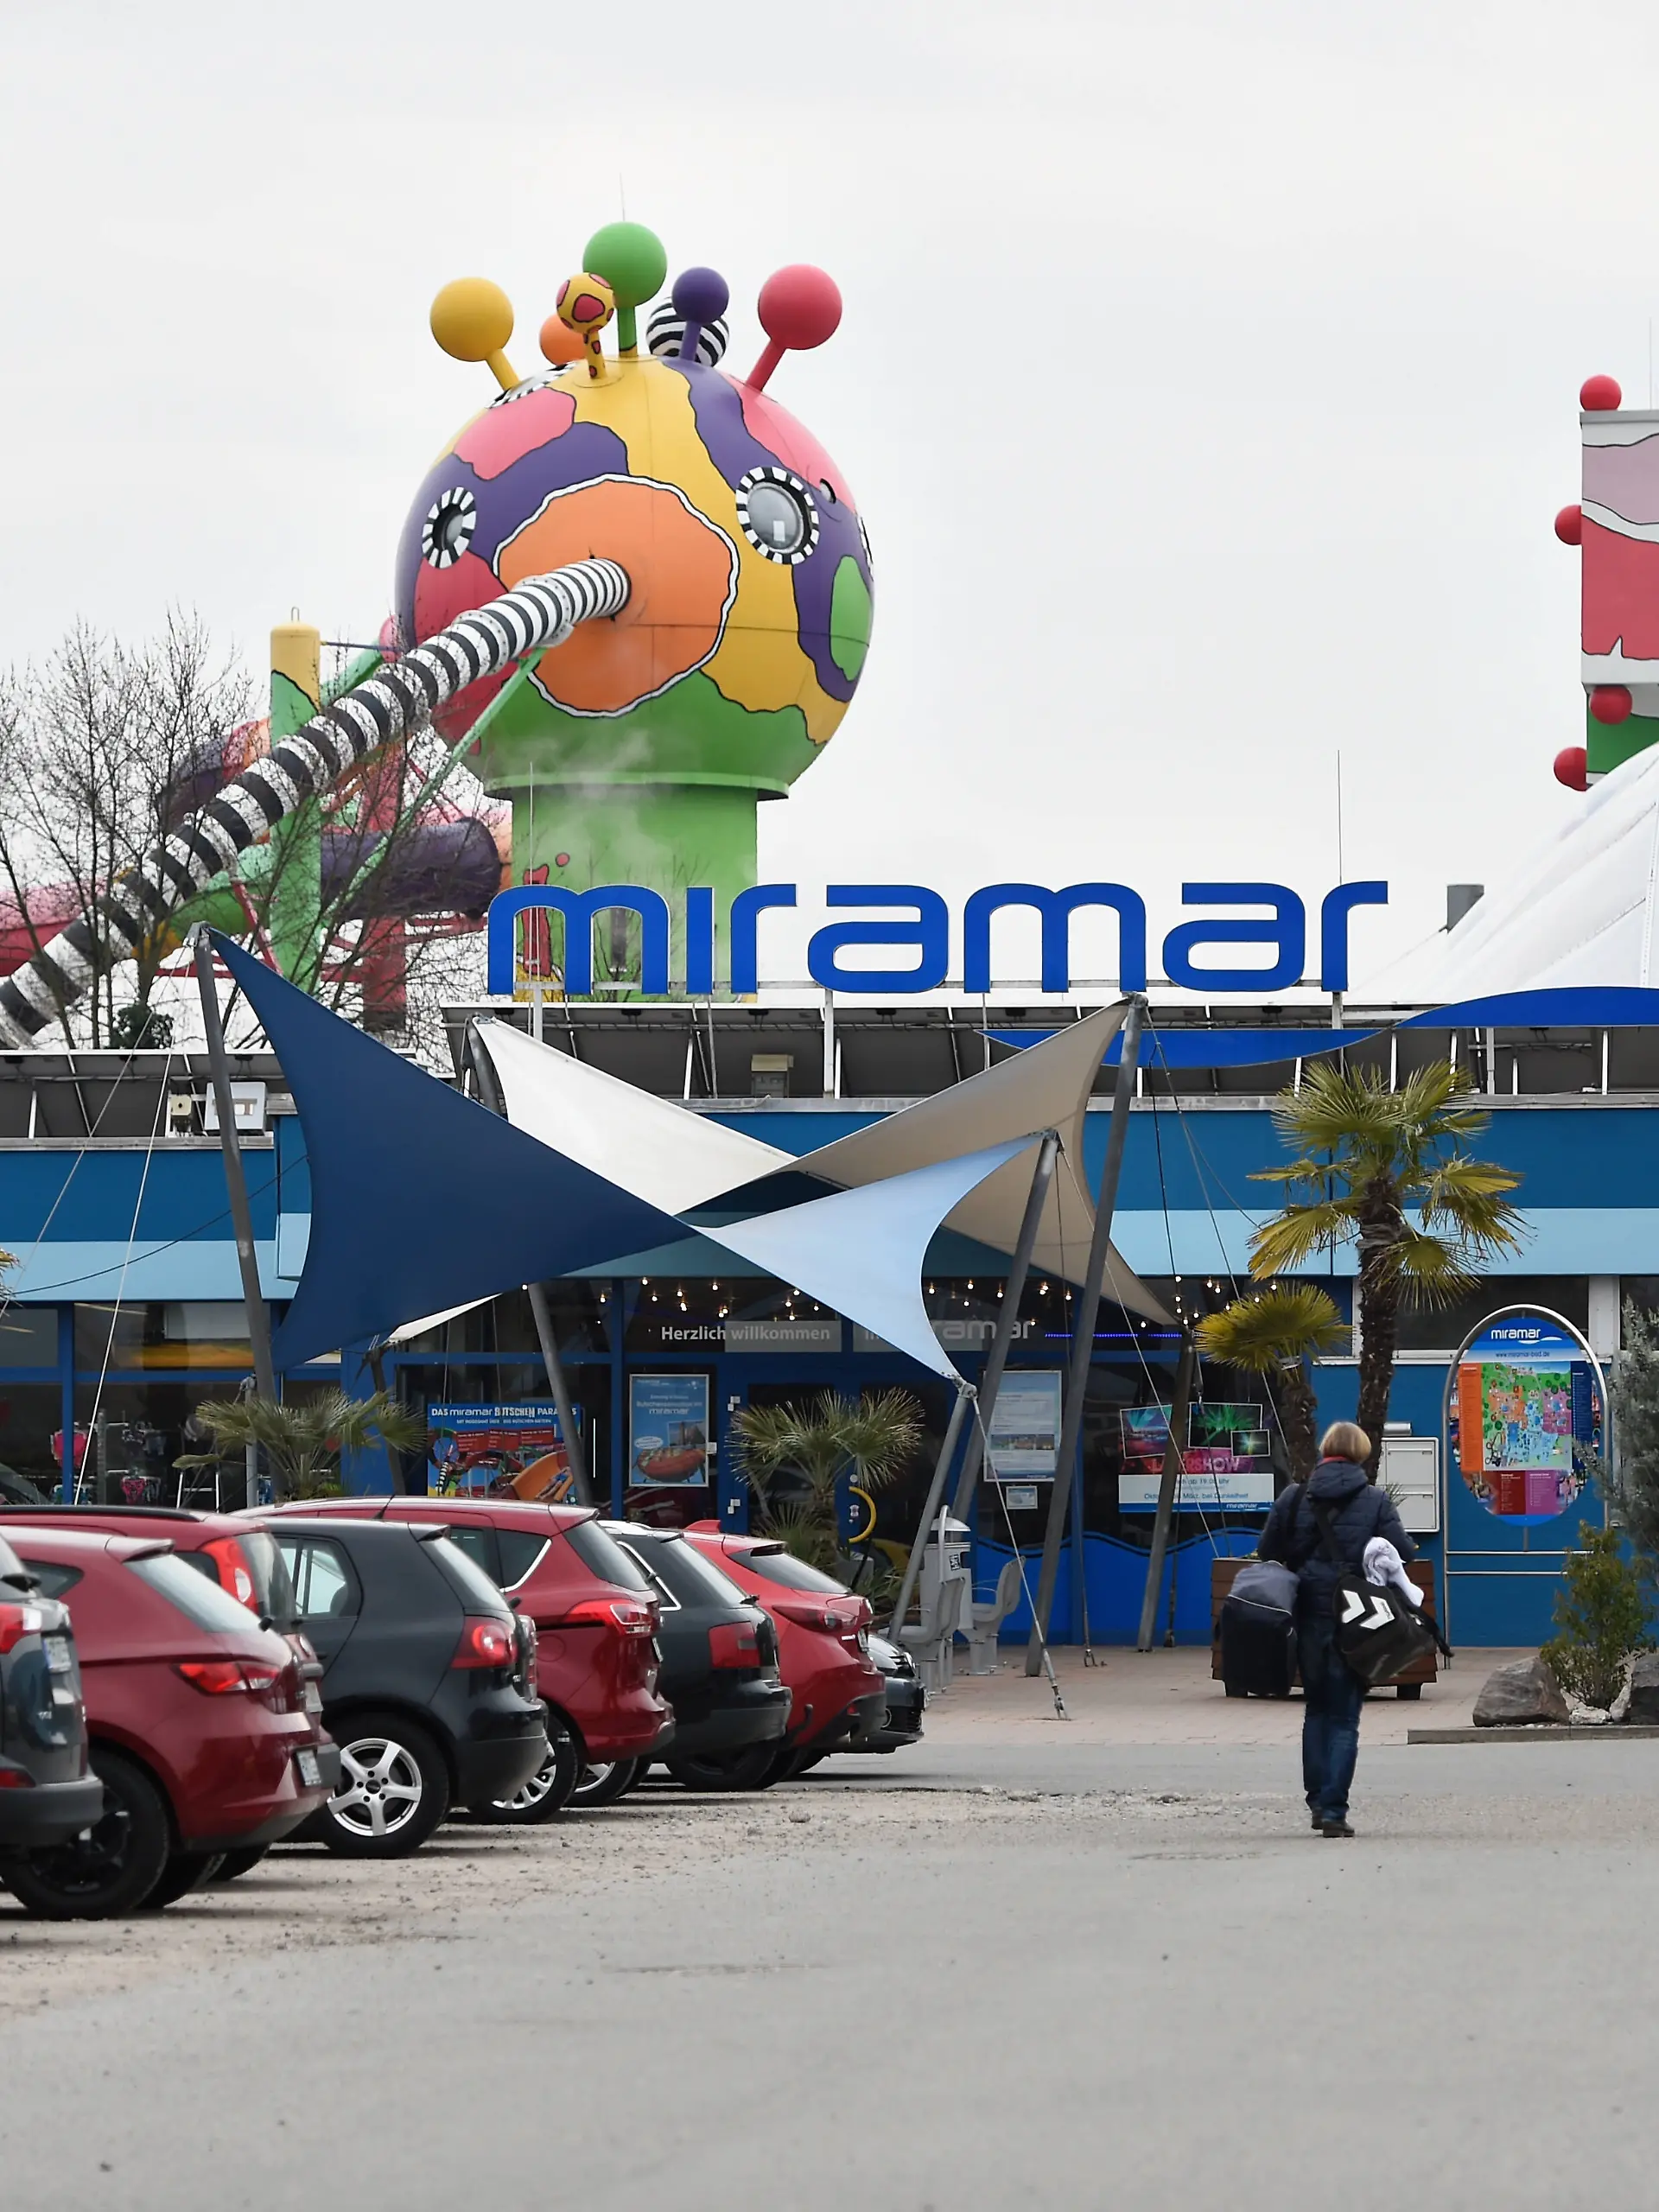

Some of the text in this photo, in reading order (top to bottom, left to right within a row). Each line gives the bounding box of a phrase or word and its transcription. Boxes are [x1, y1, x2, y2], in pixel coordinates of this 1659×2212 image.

[487, 880, 1388, 995] miramar
[661, 1325, 726, 1340] Herzlich
[731, 1325, 830, 1340] willkommen
[1491, 1328, 1541, 1339] miramar
[431, 1408, 448, 1416] DAS
